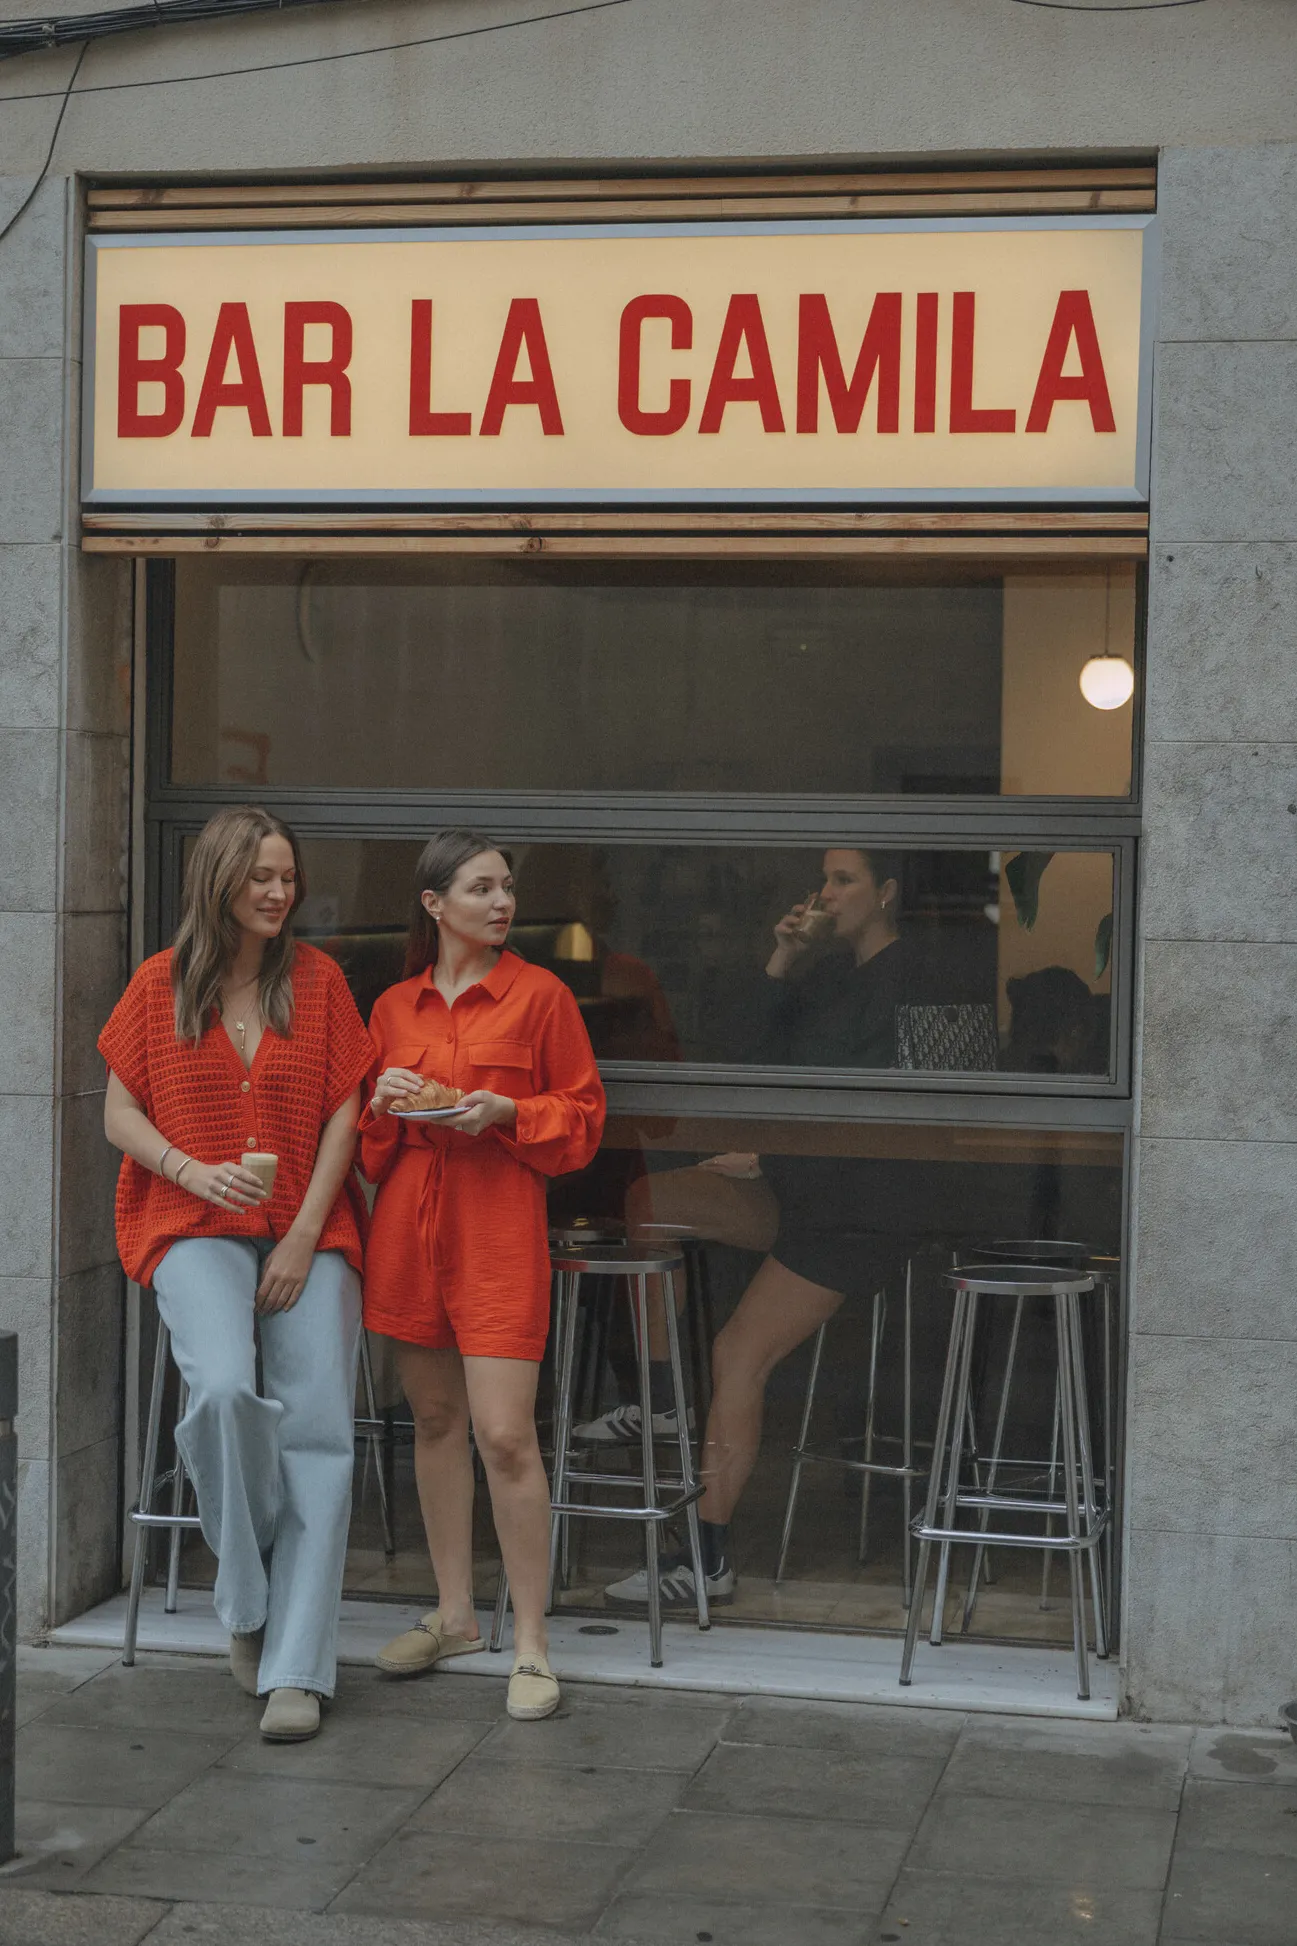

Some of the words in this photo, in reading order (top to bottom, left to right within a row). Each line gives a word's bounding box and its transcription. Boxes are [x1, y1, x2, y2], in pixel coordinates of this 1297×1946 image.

[118, 301, 353, 438] BAR
[410, 297, 565, 437] LA
[618, 290, 1117, 437] CAMILA
